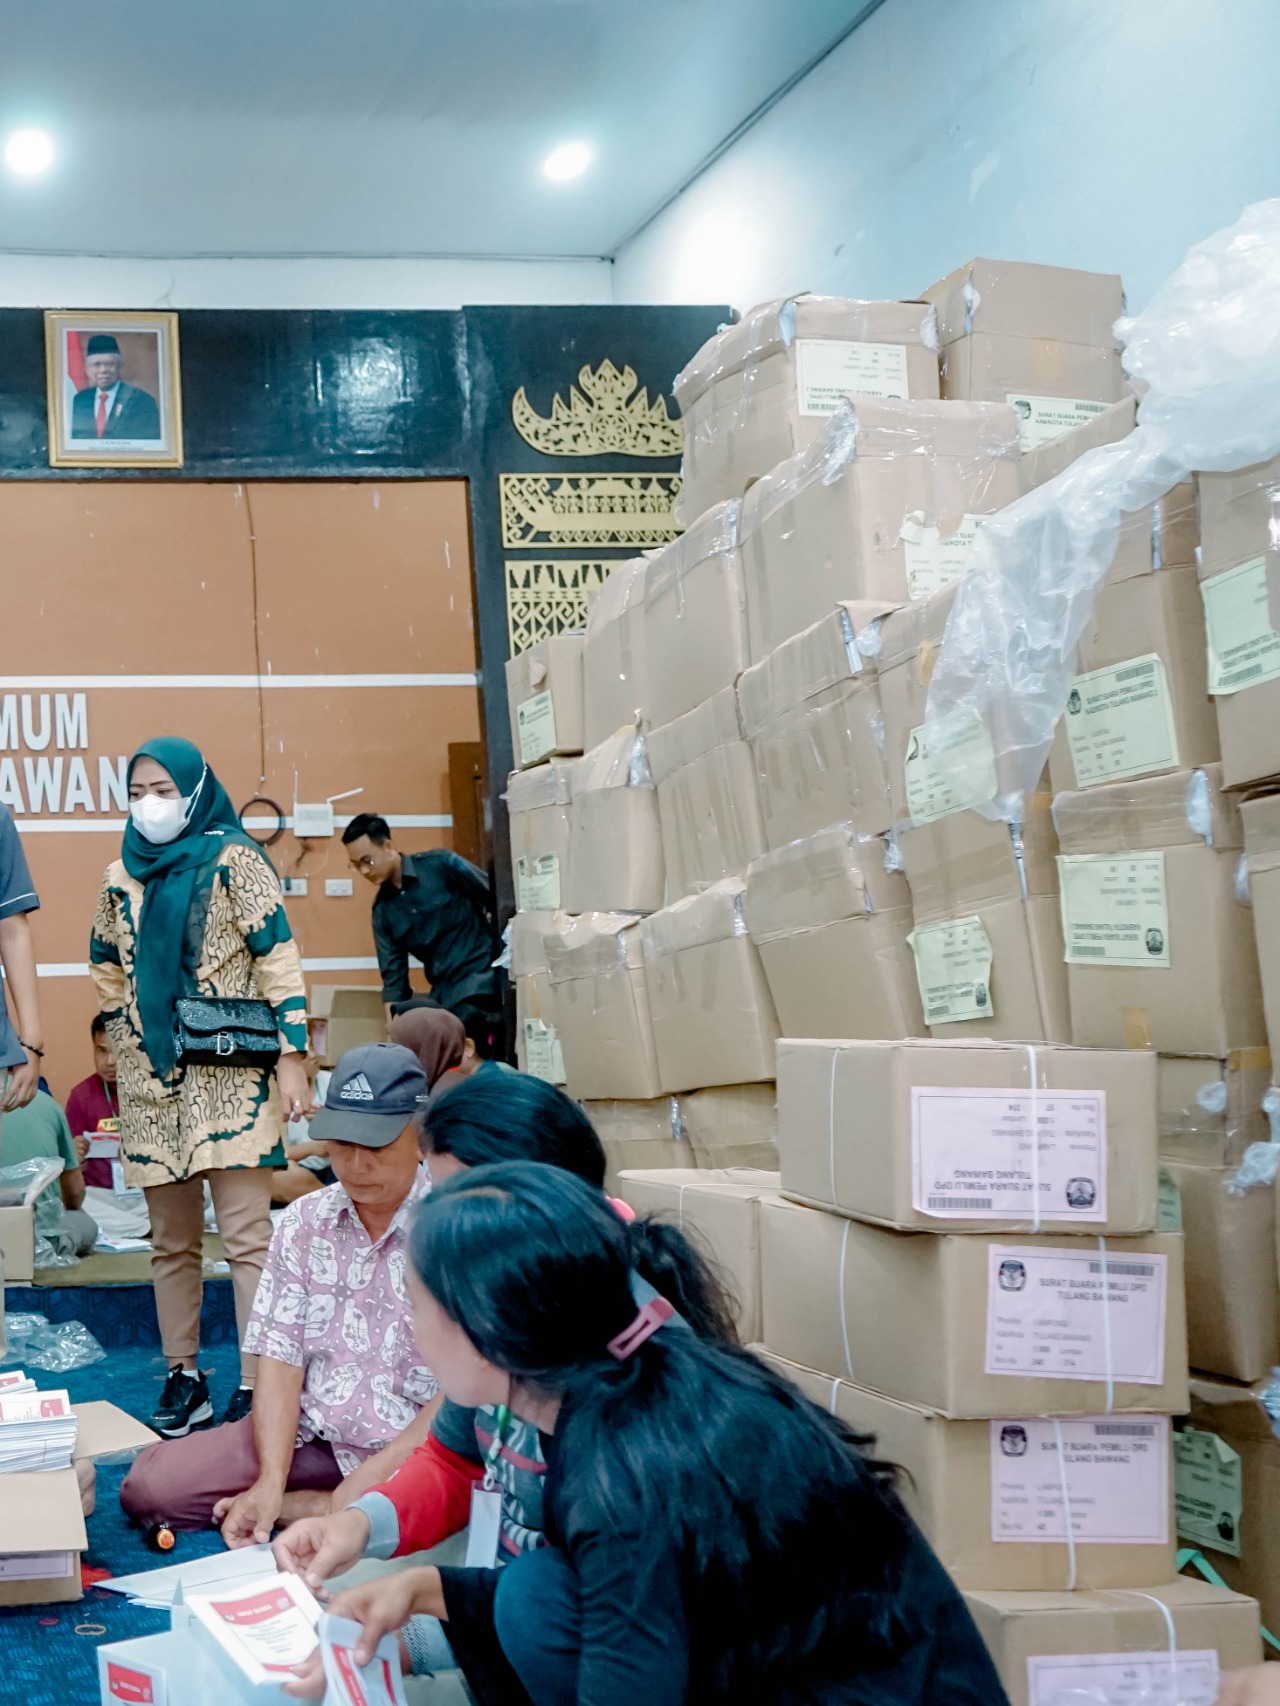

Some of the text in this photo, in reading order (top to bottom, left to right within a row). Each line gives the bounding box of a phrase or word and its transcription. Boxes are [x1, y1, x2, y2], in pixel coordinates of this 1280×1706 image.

[340, 1090, 374, 1101] adidas
[954, 1169, 994, 1179] BAWANG
[934, 1181, 1052, 1191] SUAT SUARA PEMILU DPD
